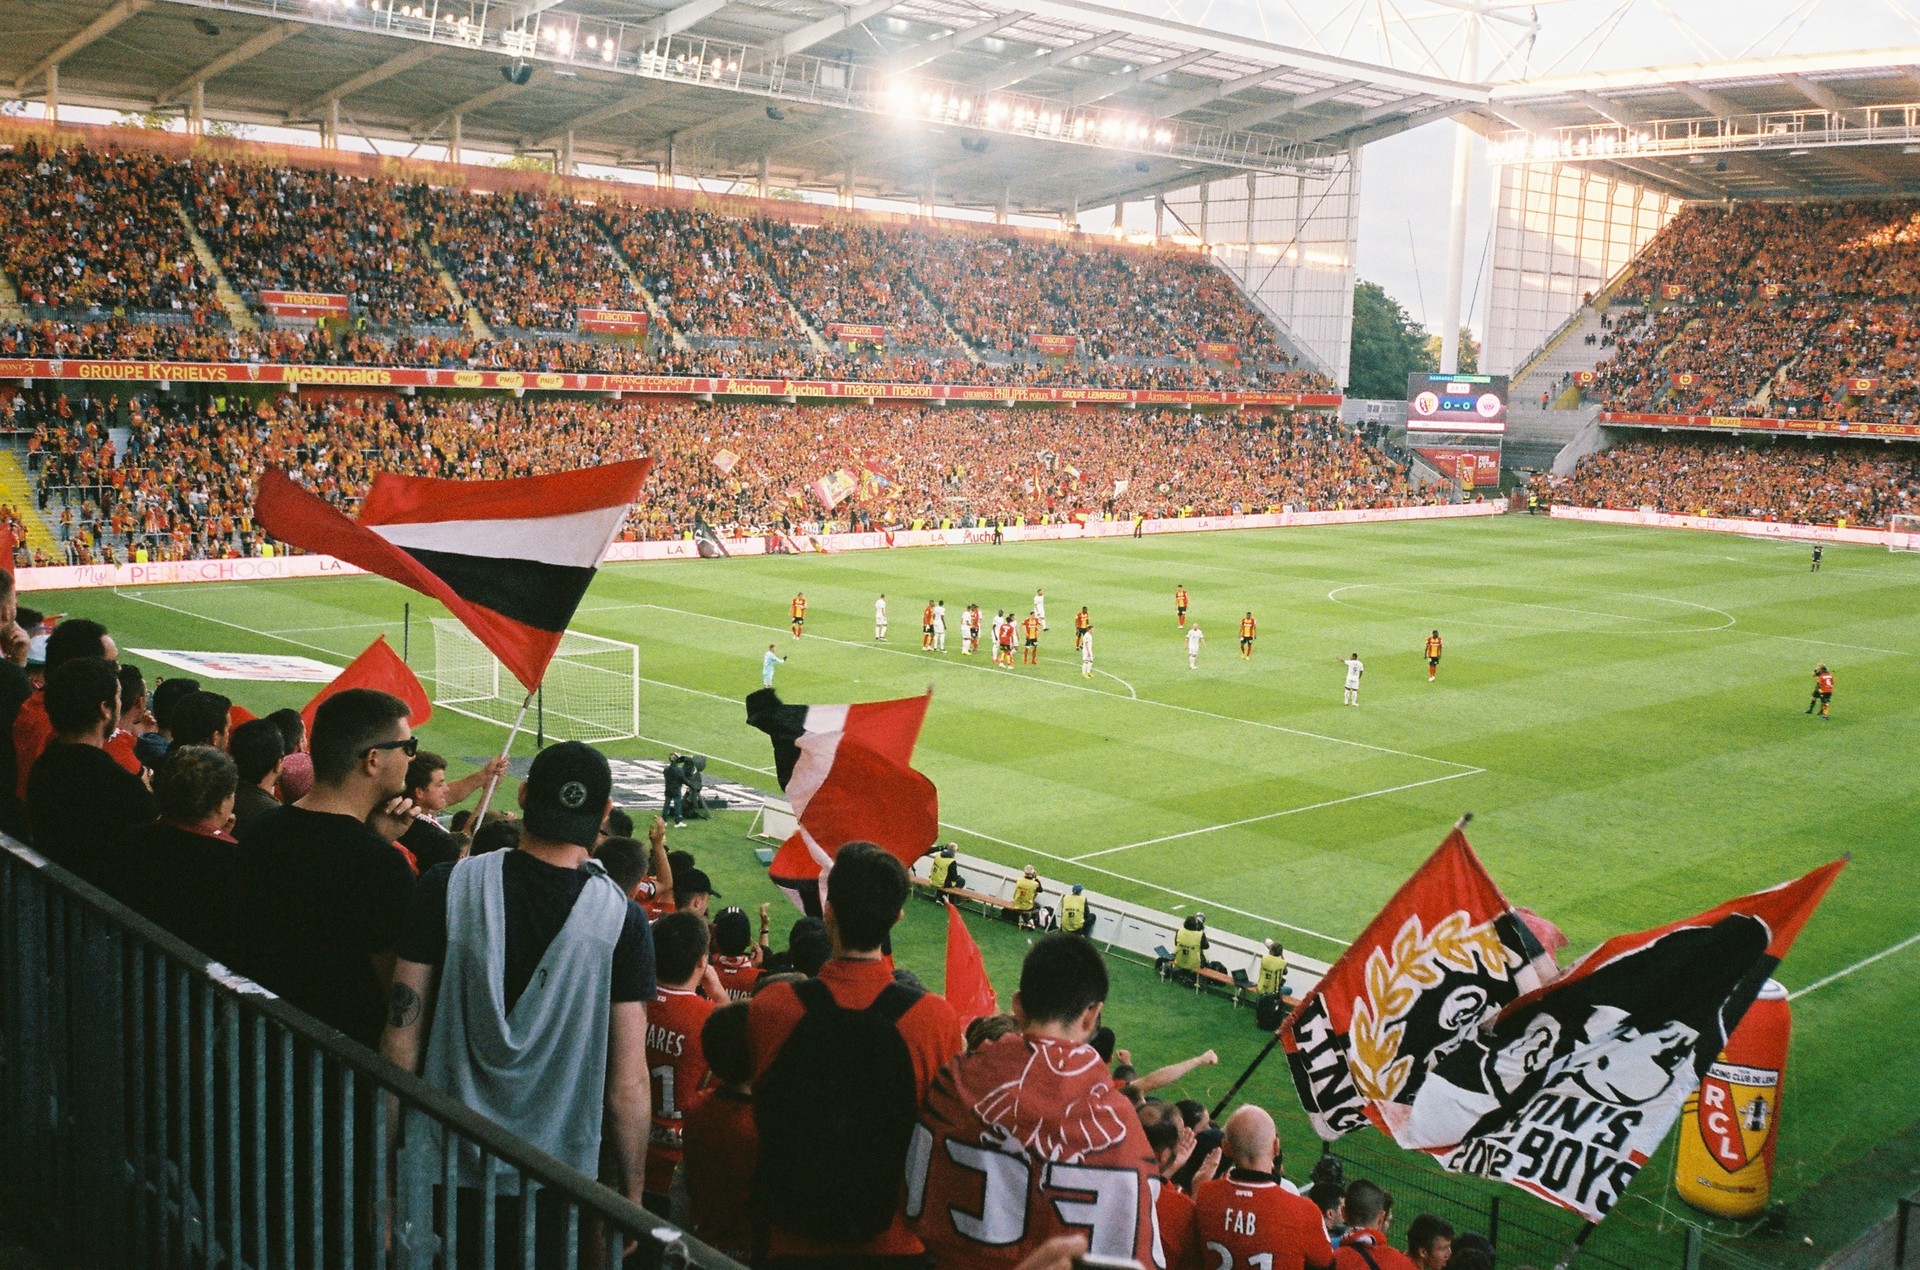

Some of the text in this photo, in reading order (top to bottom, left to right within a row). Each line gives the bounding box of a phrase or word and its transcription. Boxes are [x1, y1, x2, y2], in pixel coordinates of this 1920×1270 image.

[597, 311, 633, 322] macron
[79, 364, 228, 381] GROUPE KYRIELYS
[282, 367, 392, 384] McDonald's
[610, 377, 687, 386] FRANCE CONFORT
[727, 379, 771, 394] Auchan
[784, 380, 826, 395] Auchan
[844, 384, 886, 396] macron
[892, 386, 933, 397] macron
[994, 388, 1028, 400] PHILIPPE
[1061, 390, 1085, 399] GROUPE
[1444, 401, 1451, 409] 0
[1463, 402, 1470, 410] 0
[931, 533, 945, 542] LA
[667, 545, 684, 555] LA
[320, 560, 341, 571] LA
[647, 1024, 686, 1058] ARES
[1709, 1068, 1777, 1084] ACING CLUB DE LENS
[1704, 1083, 1739, 1160] RCL
[1516, 1126, 1641, 1215] BOYS
[1224, 1207, 1257, 1236] FAB
